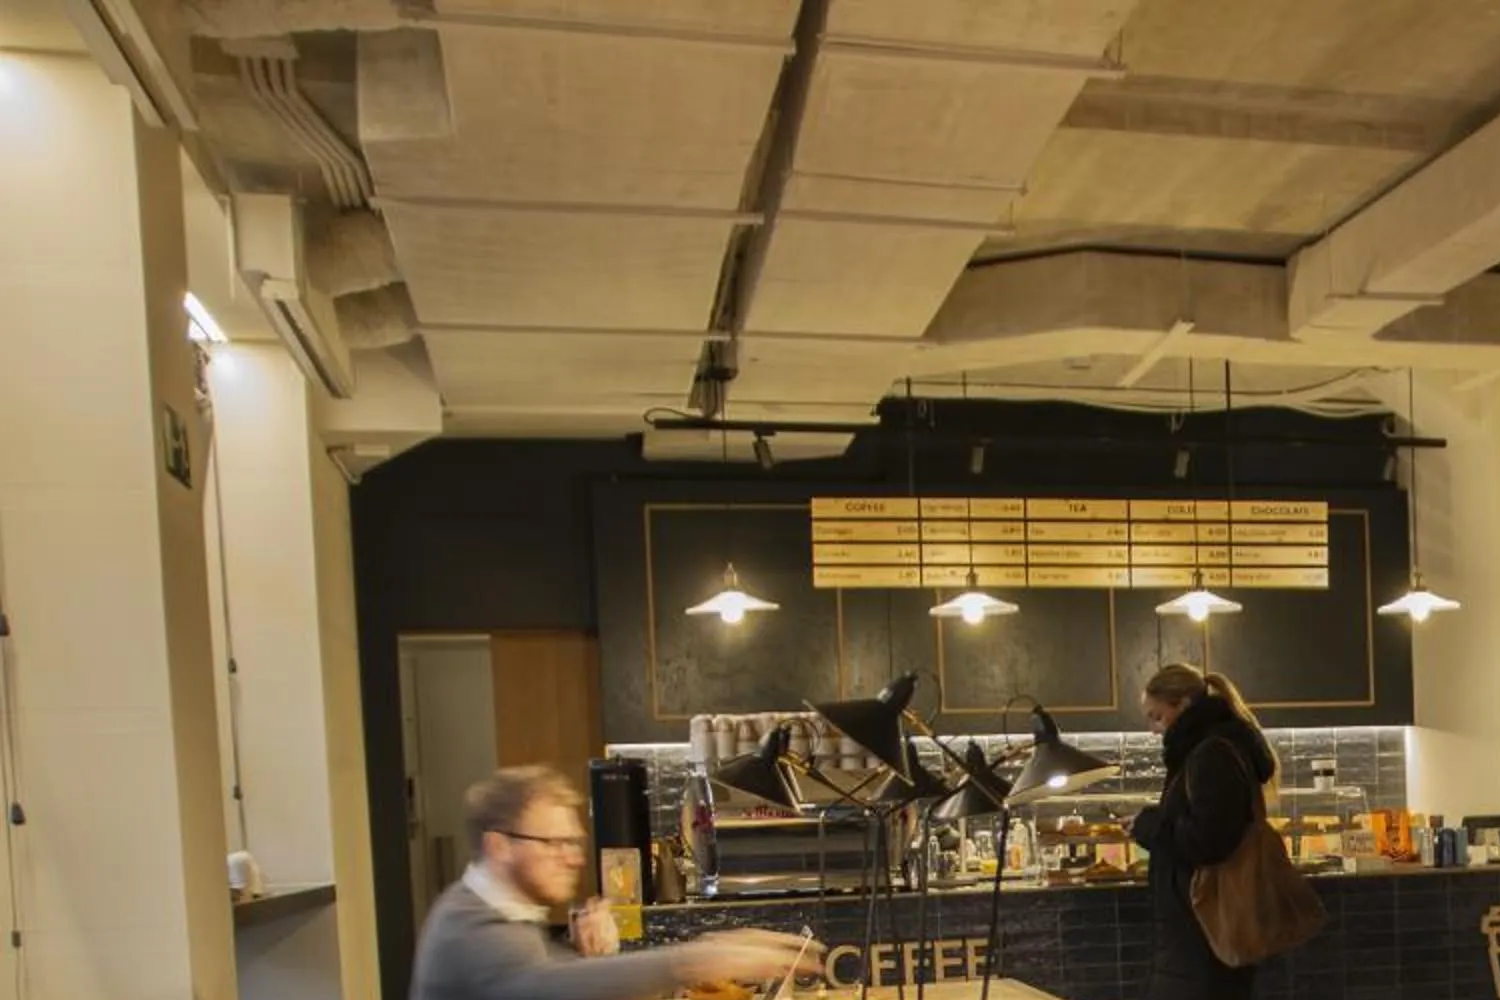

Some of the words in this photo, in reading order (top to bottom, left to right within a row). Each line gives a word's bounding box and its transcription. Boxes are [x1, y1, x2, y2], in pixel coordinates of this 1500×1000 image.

[845, 501, 886, 513] COFFEE
[1068, 503, 1087, 513] TEA
[793, 937, 998, 988] OFFEE
